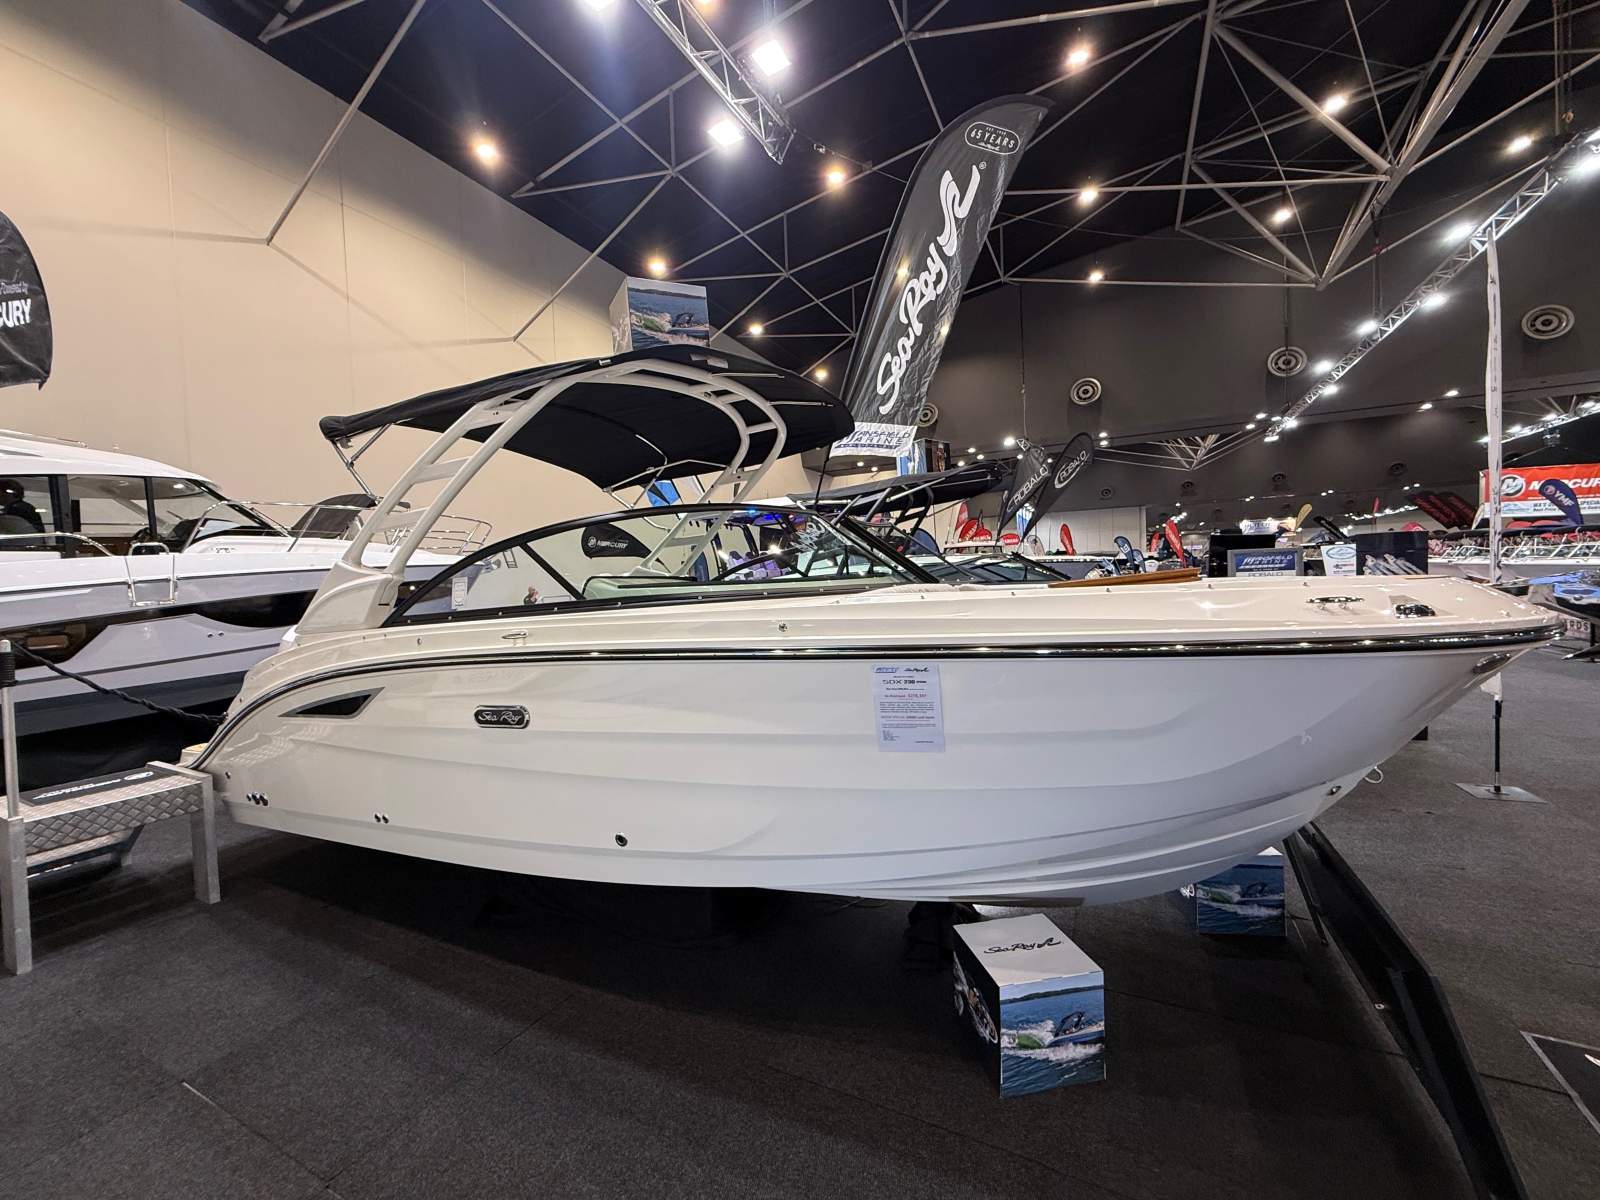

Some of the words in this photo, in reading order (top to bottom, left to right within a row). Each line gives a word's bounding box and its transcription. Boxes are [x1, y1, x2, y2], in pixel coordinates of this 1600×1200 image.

[970, 128, 983, 140] 65
[983, 131, 1015, 149] YEARS
[877, 327, 915, 415] Sea
[900, 242, 949, 338] Ray
[1013, 463, 1049, 506] ROBALO
[1528, 478, 1600, 490] MCUR
[596, 539, 629, 550] MERCURY
[478, 711, 498, 722] Sea
[500, 710, 523, 725] Ray
[983, 946, 1010, 954] Sea
[1011, 942, 1036, 951] Ray
